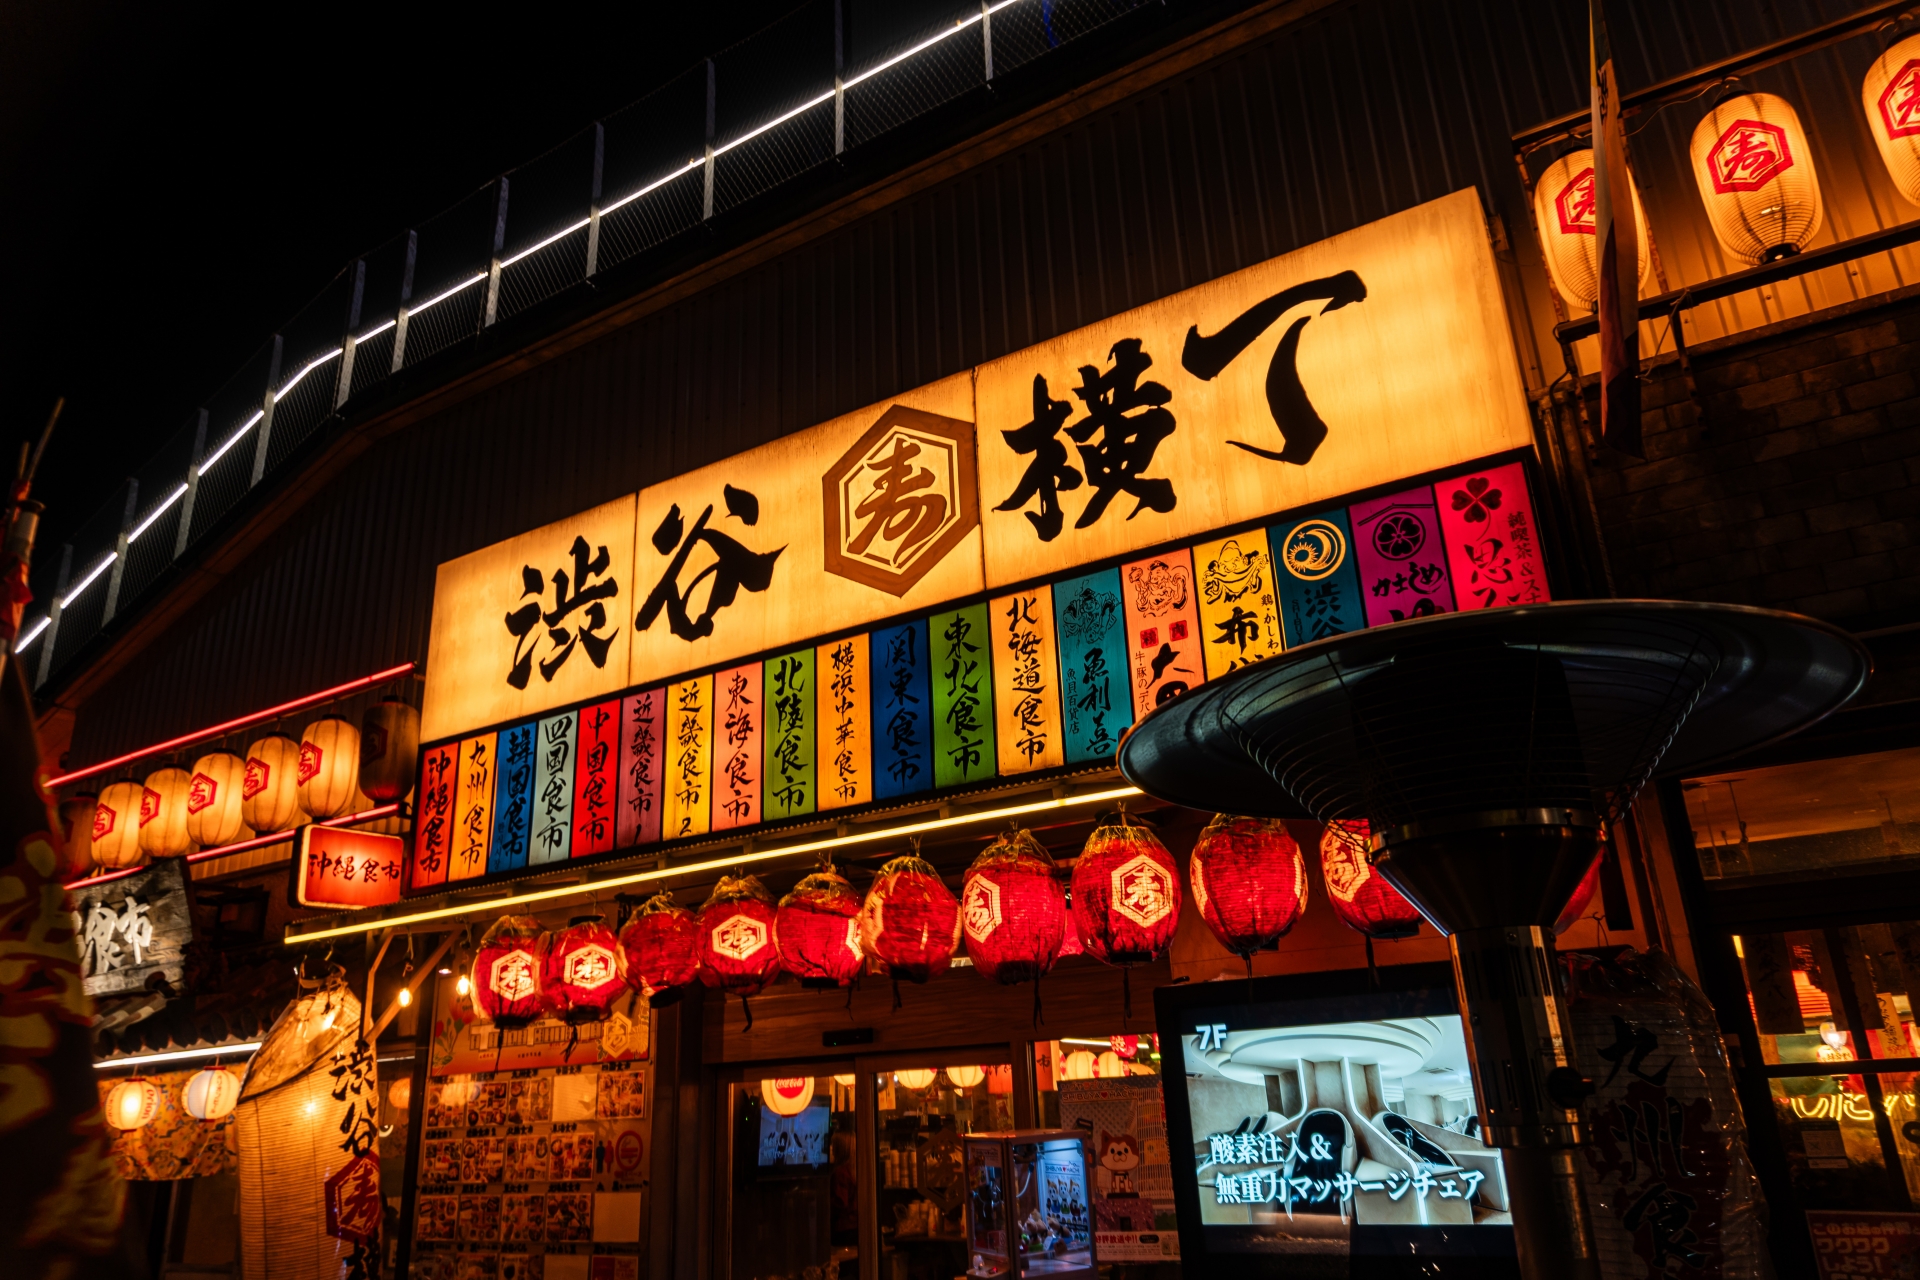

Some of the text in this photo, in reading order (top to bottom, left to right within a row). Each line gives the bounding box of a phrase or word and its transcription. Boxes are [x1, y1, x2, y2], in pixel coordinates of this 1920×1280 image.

[1723, 132, 1776, 183] 寿
[505, 269, 1368, 690] 渋谷 寿 横丁
[722, 671, 755, 825] 東海食市
[772, 656, 808, 815] 北陸食市
[830, 642, 858, 803] 横浜中華食市
[885, 625, 922, 793] 関東食市
[943, 612, 985, 780] 東北食市
[1006, 597, 1047, 767] 北海道食市
[1066, 667, 1080, 735] 魚貝百貨店
[1135, 651, 1150, 714] 牛・豚のデパ
[420, 749, 452, 883] 沖縄食市
[460, 740, 488, 875] 九州食市
[502, 727, 534, 867] 韓国食市
[536, 715, 574, 859] 四国食市
[579, 707, 610, 848] 中国食市
[675, 681, 704, 836] 近畿食市2
[309, 850, 400, 884] 沖縄食市
[1125, 864, 1165, 917] 寿
[329, 1039, 378, 1158] 渋谷
[1195, 1023, 1228, 1051] 7F
[1210, 1132, 1333, 1165] 酸素注入&
[1215, 1170, 1486, 1205] 無重力マッサージチェア
[1597, 1015, 1709, 1277] 九州食
[1816, 1237, 1890, 1254] ワクワク
